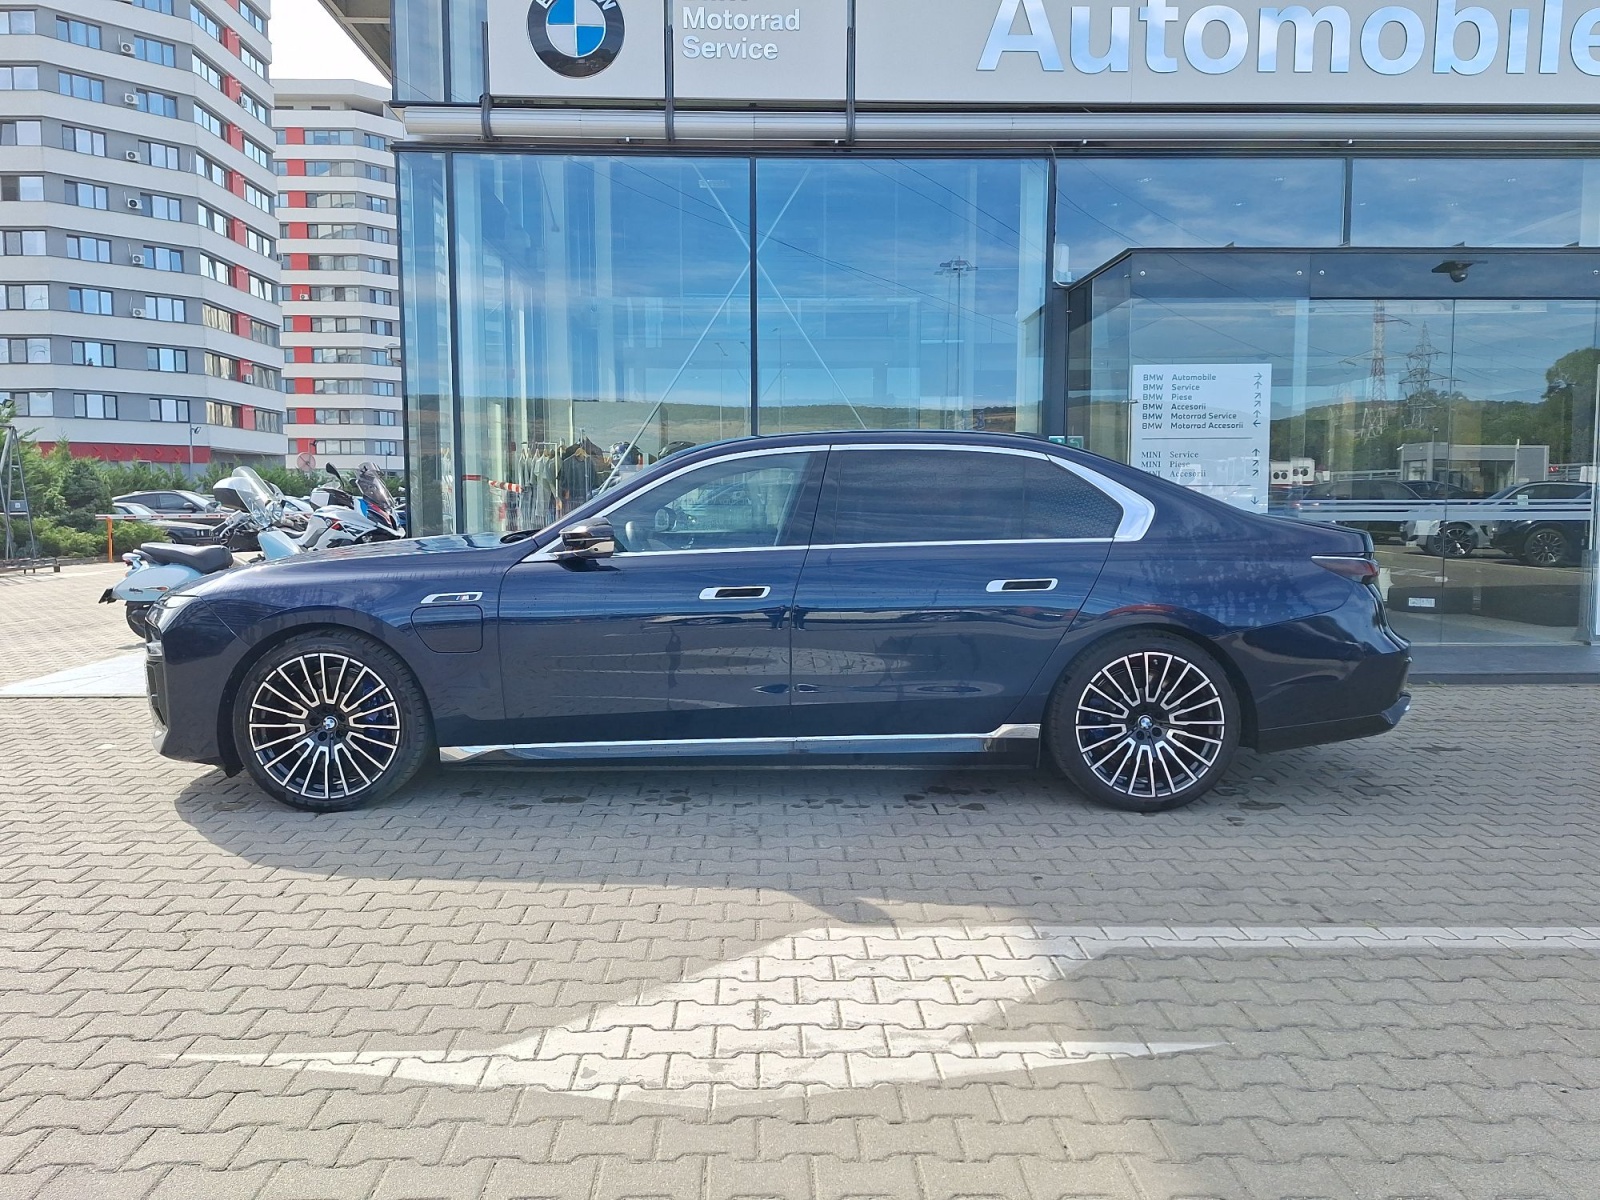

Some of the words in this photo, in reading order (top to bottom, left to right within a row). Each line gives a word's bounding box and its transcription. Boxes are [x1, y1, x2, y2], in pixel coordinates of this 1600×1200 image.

[682, 6, 801, 31] Motorrad
[682, 35, 778, 60] Service
[1172, 373, 1217, 381] Automobile
[1171, 383, 1200, 391] Service
[1142, 393, 1163, 401] BMW
[1171, 393, 1193, 401] Piese
[1170, 412, 1207, 420] Motorrad
[1141, 422, 1163, 430] BMW
[1208, 421, 1244, 429] Accesorii
[1169, 450, 1199, 458] Service
[1169, 460, 1191, 468] Piese
[1169, 469, 1206, 477] Accesorii
